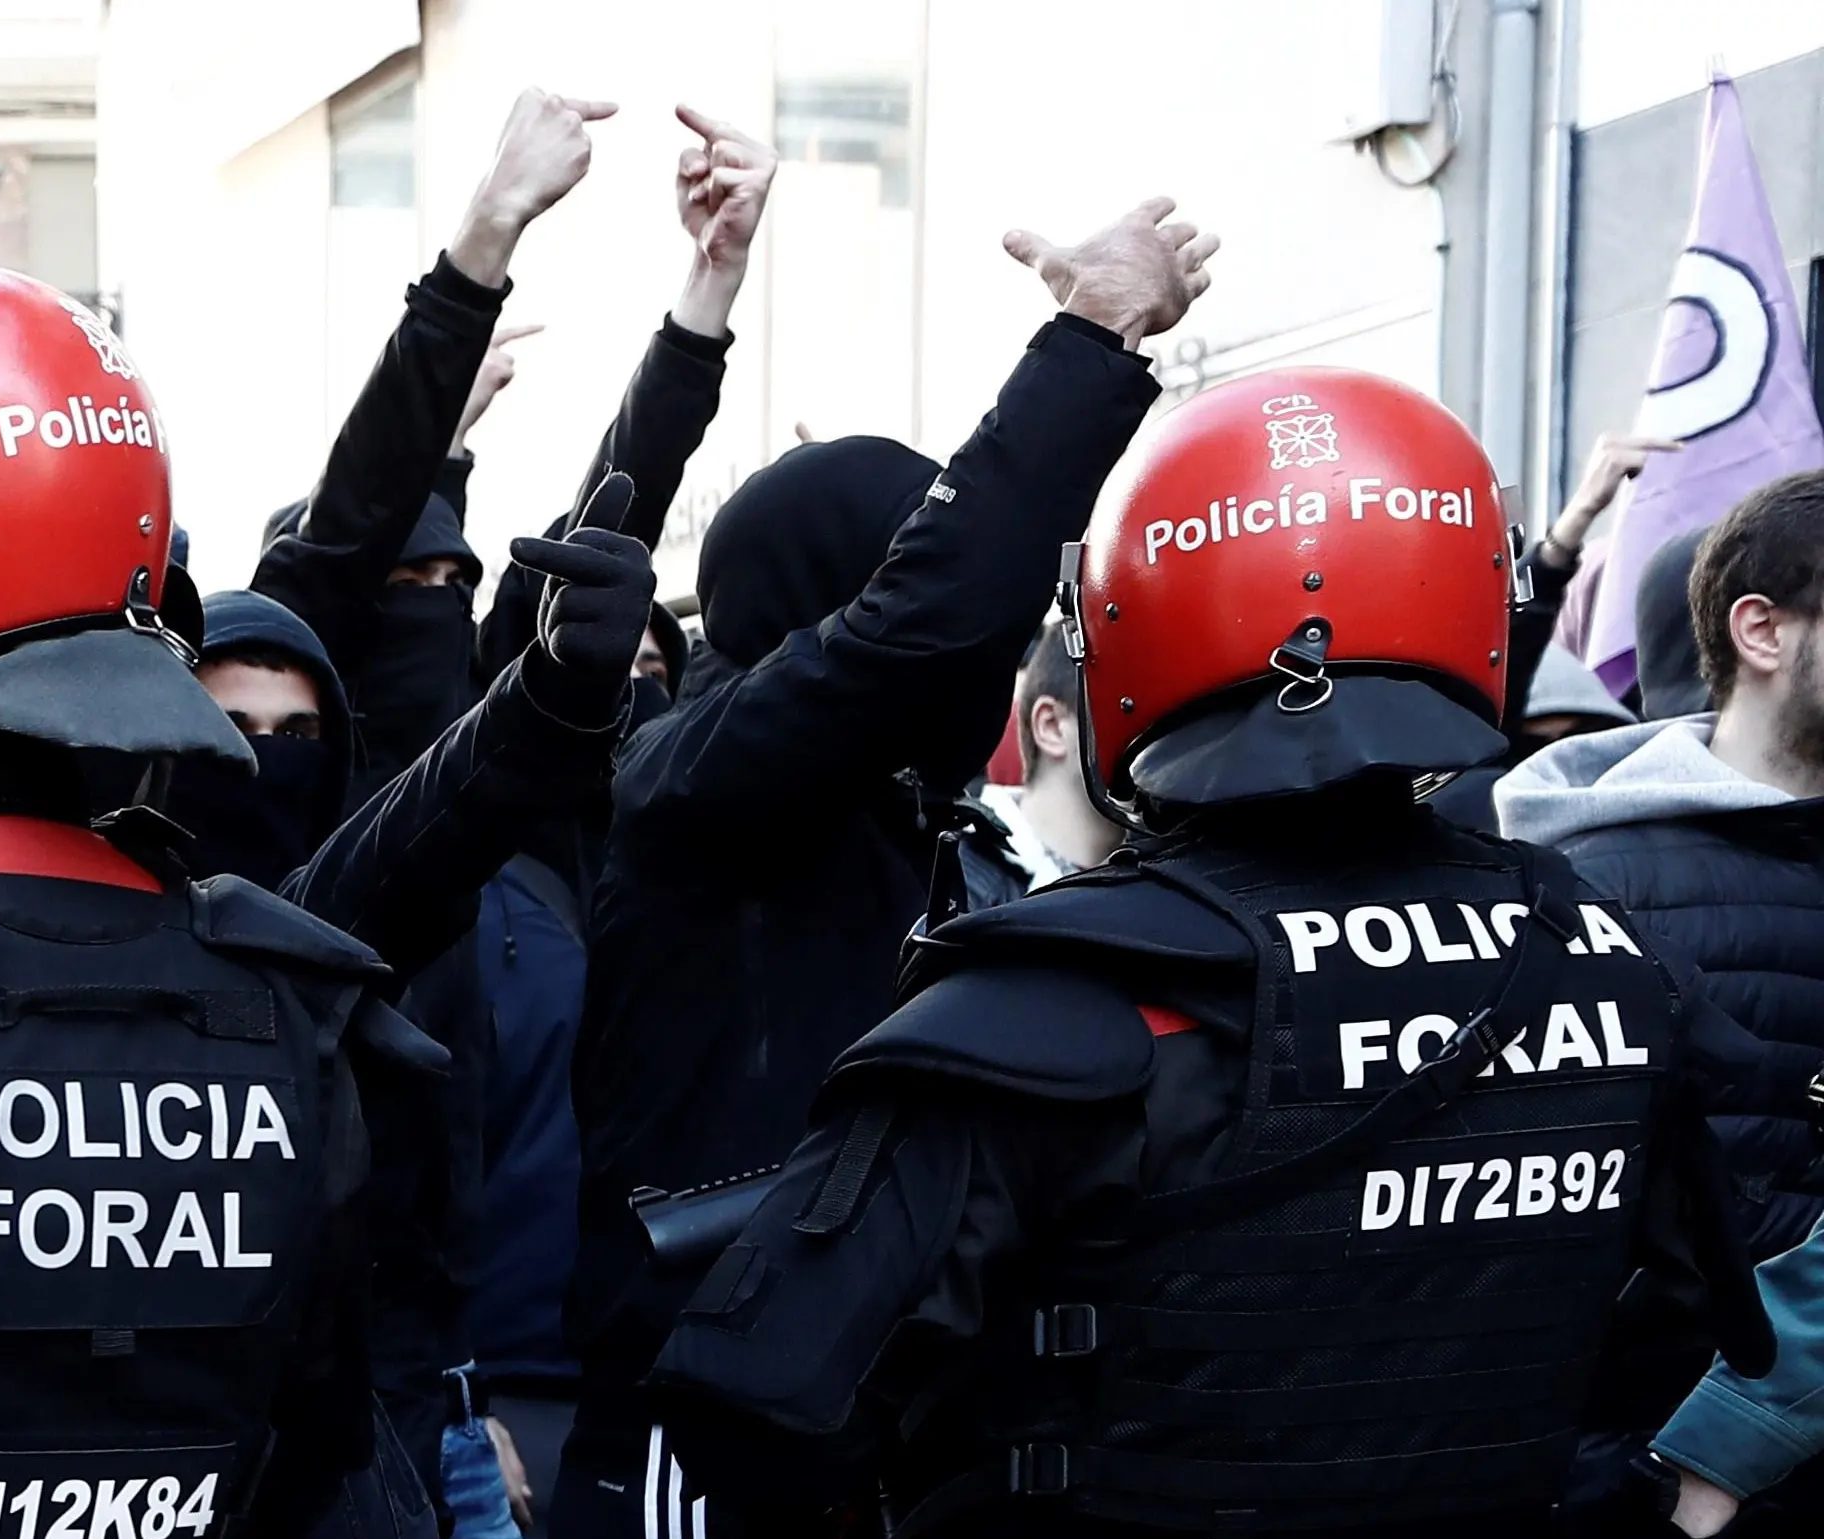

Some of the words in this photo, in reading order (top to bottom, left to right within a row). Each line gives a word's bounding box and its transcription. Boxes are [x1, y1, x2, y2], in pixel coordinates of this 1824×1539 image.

[1145, 483, 1327, 565] Policía
[1350, 478, 1474, 528] Foral
[1360, 1149, 1626, 1231] DI72B92
